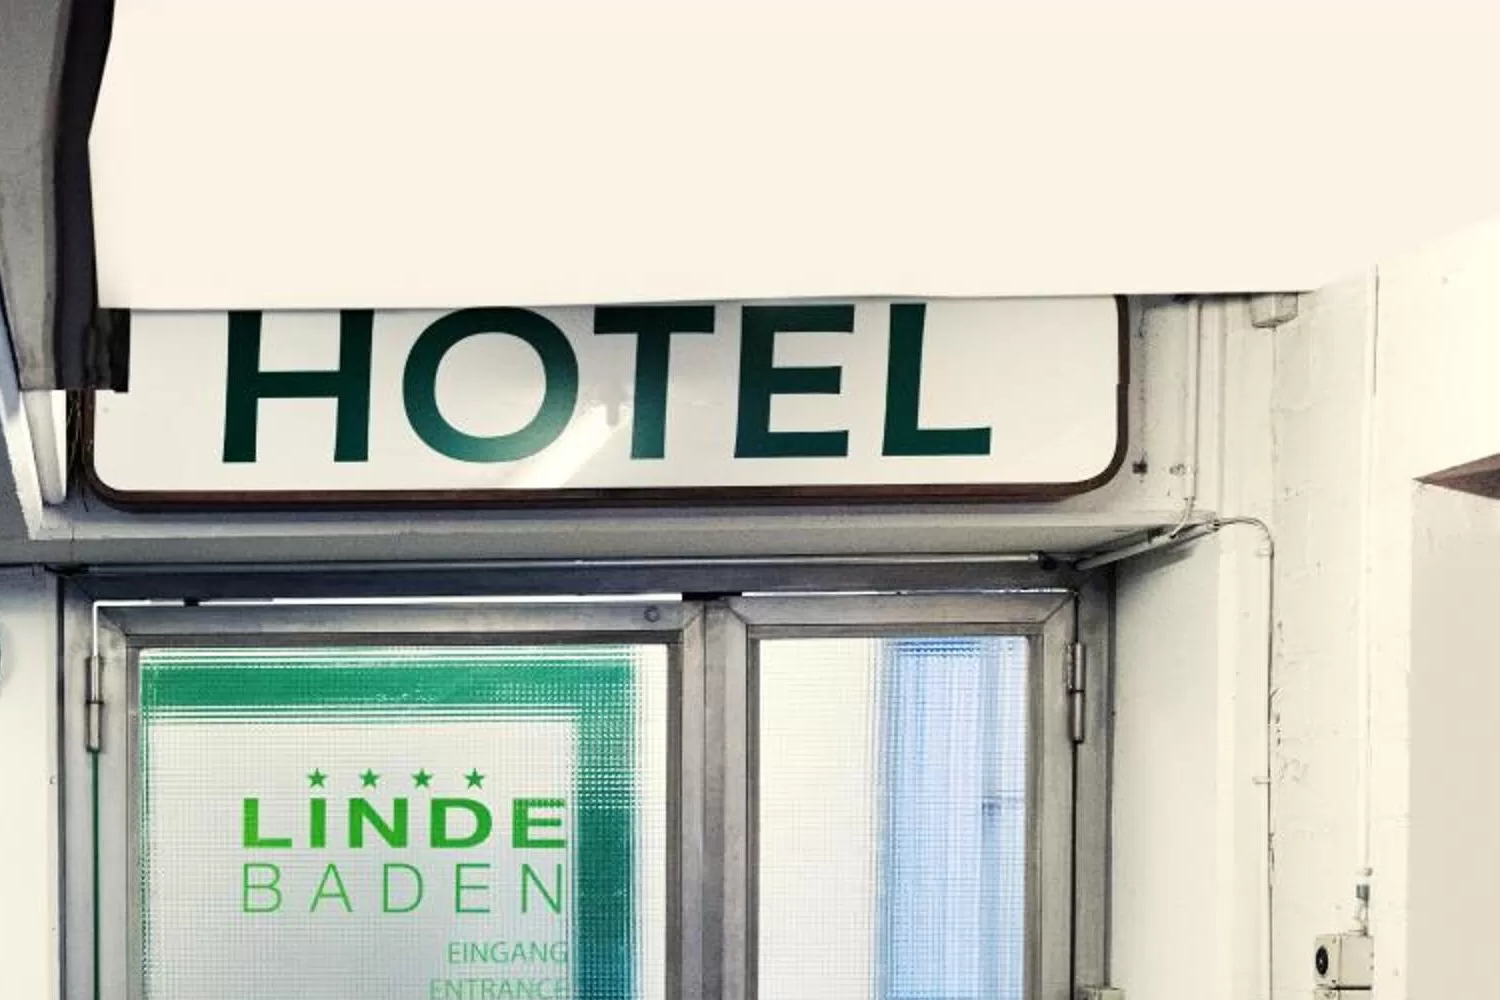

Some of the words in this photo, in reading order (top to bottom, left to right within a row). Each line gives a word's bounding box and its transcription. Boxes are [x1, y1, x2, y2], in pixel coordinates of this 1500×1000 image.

[221, 303, 992, 463] HOTEL
[242, 797, 565, 848] LINDE
[242, 862, 562, 913] BADEN
[447, 941, 569, 965] EINGANG
